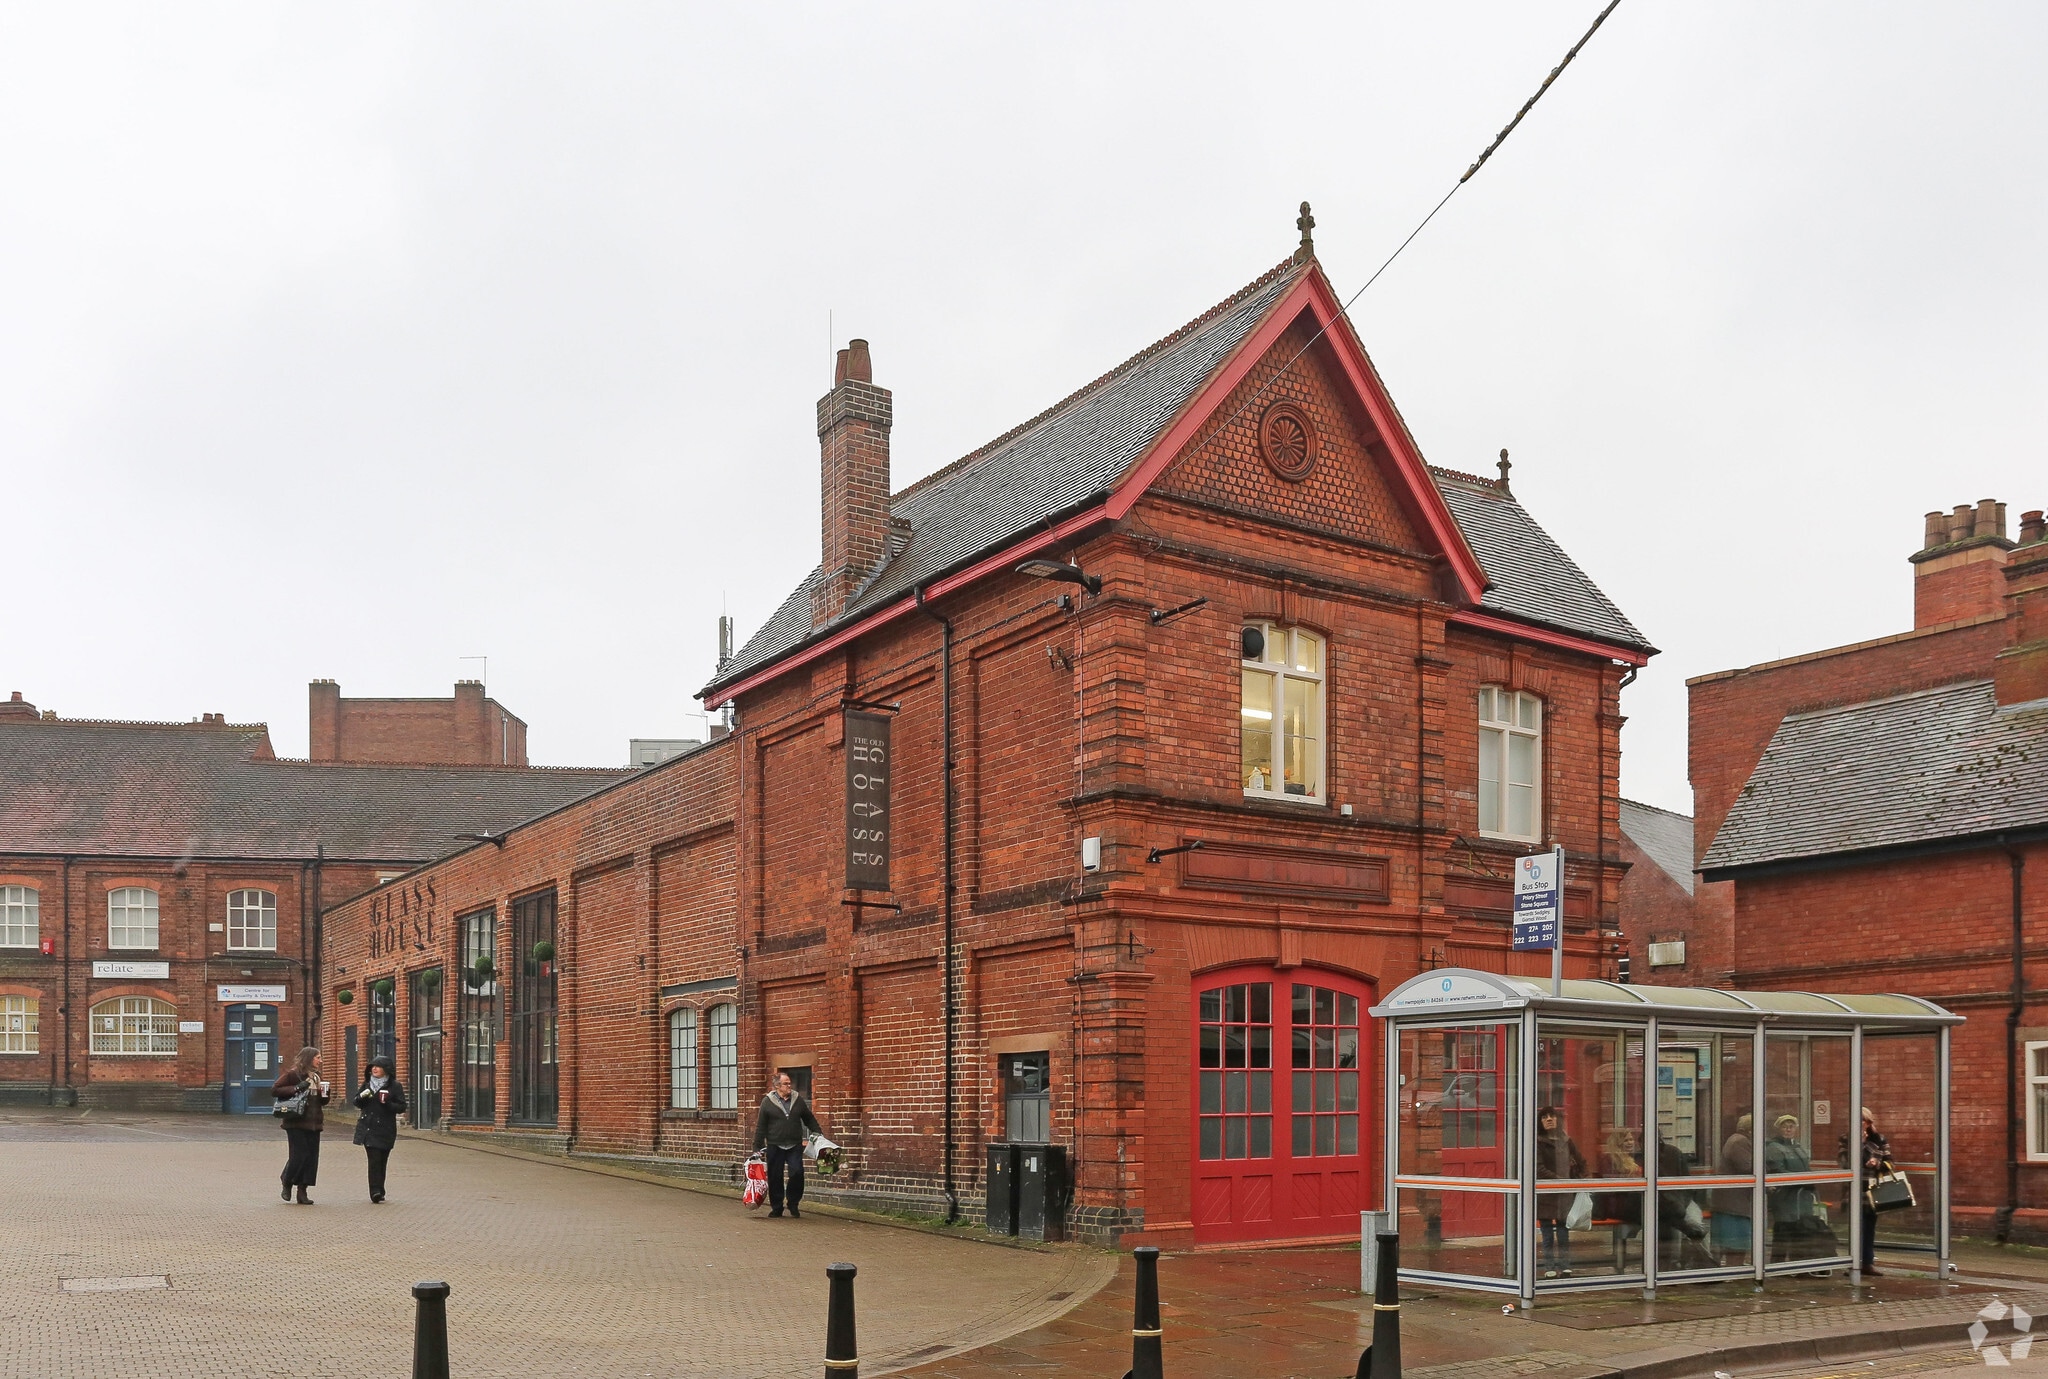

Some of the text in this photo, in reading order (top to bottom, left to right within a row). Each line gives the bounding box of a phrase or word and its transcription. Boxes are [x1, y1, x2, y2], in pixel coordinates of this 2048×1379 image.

[852, 745, 868, 866] HOUSE
[869, 747, 884, 866] GLASS
[370, 875, 436, 926] GLASS
[1534, 882, 1548, 890] Stop
[370, 910, 436, 959] HOUSE
[98, 964, 134, 972] relate
